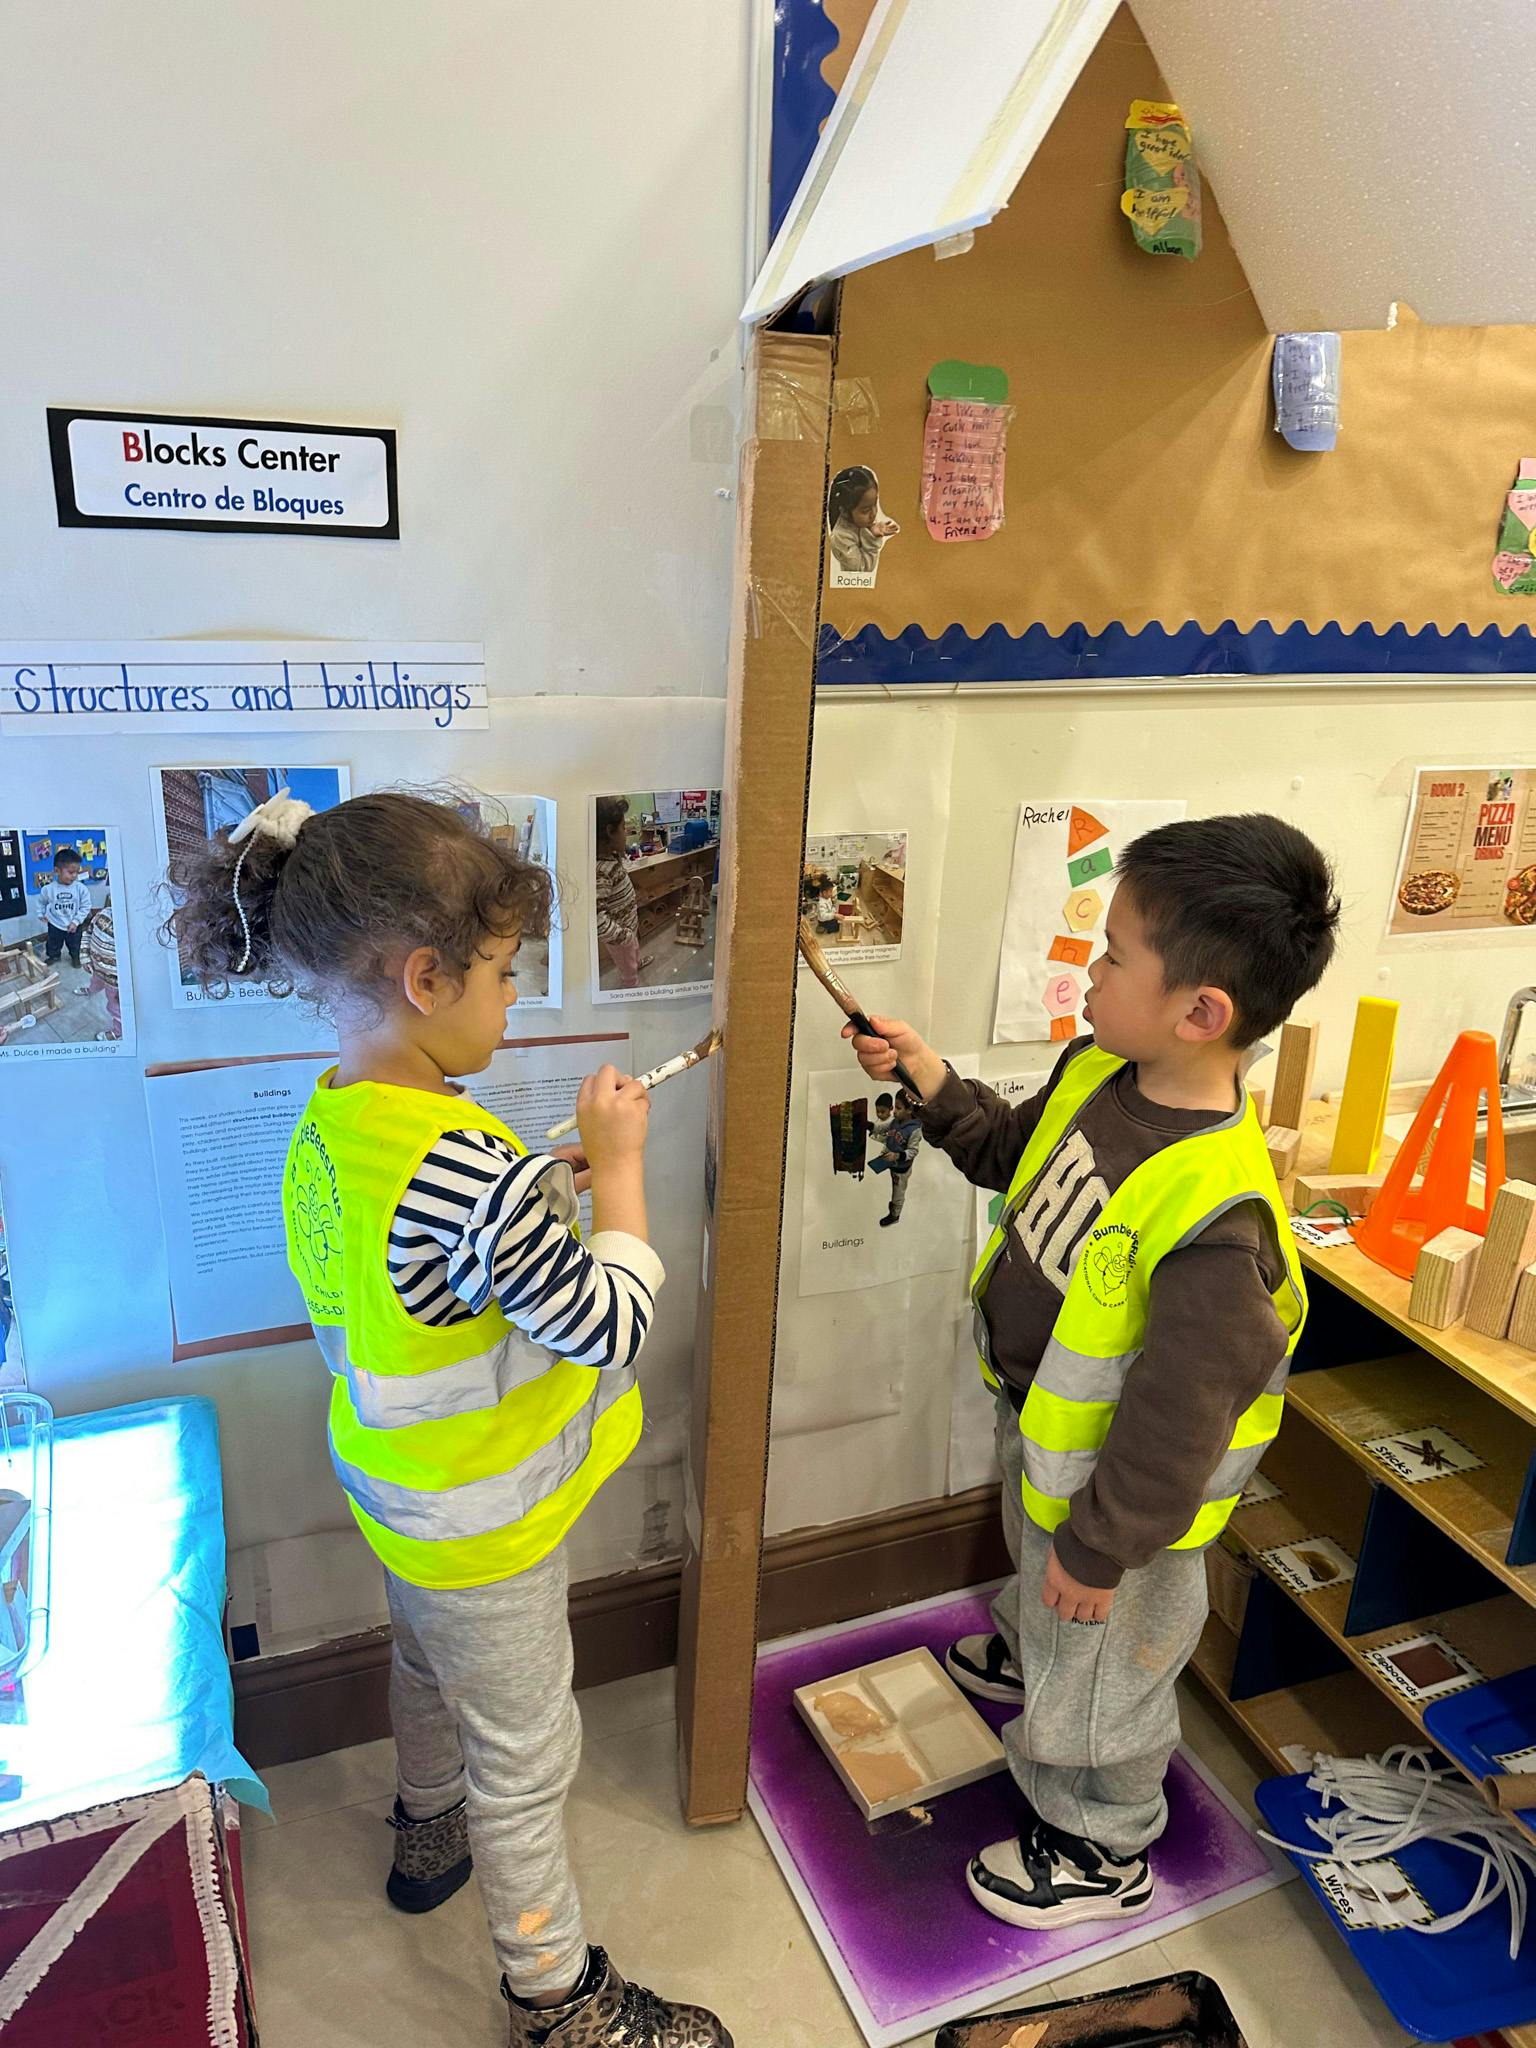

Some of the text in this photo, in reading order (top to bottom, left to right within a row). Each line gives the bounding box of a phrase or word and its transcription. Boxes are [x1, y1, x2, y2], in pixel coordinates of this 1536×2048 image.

[123, 429, 340, 473] Blocks Center
[124, 483, 344, 520] Centro de Bloques
[837, 576, 872, 588] Rachel
[14, 660, 470, 728] Structures and buildings
[1023, 806, 1069, 829] Rachel
[1479, 803, 1515, 825] PIZZA
[1473, 826, 1512, 846] MENU
[14, 1049, 39, 1057] Dulce
[253, 1088, 292, 1098] Buildings
[1290, 1220, 1324, 1242] Cones
[822, 1236, 864, 1250] Buildings
[1375, 1444, 1413, 1476] Sticks
[1269, 1552, 1308, 1590] Hard Hat
[1372, 1652, 1419, 1698] Clipboards
[1325, 1874, 1354, 1916] Wires
